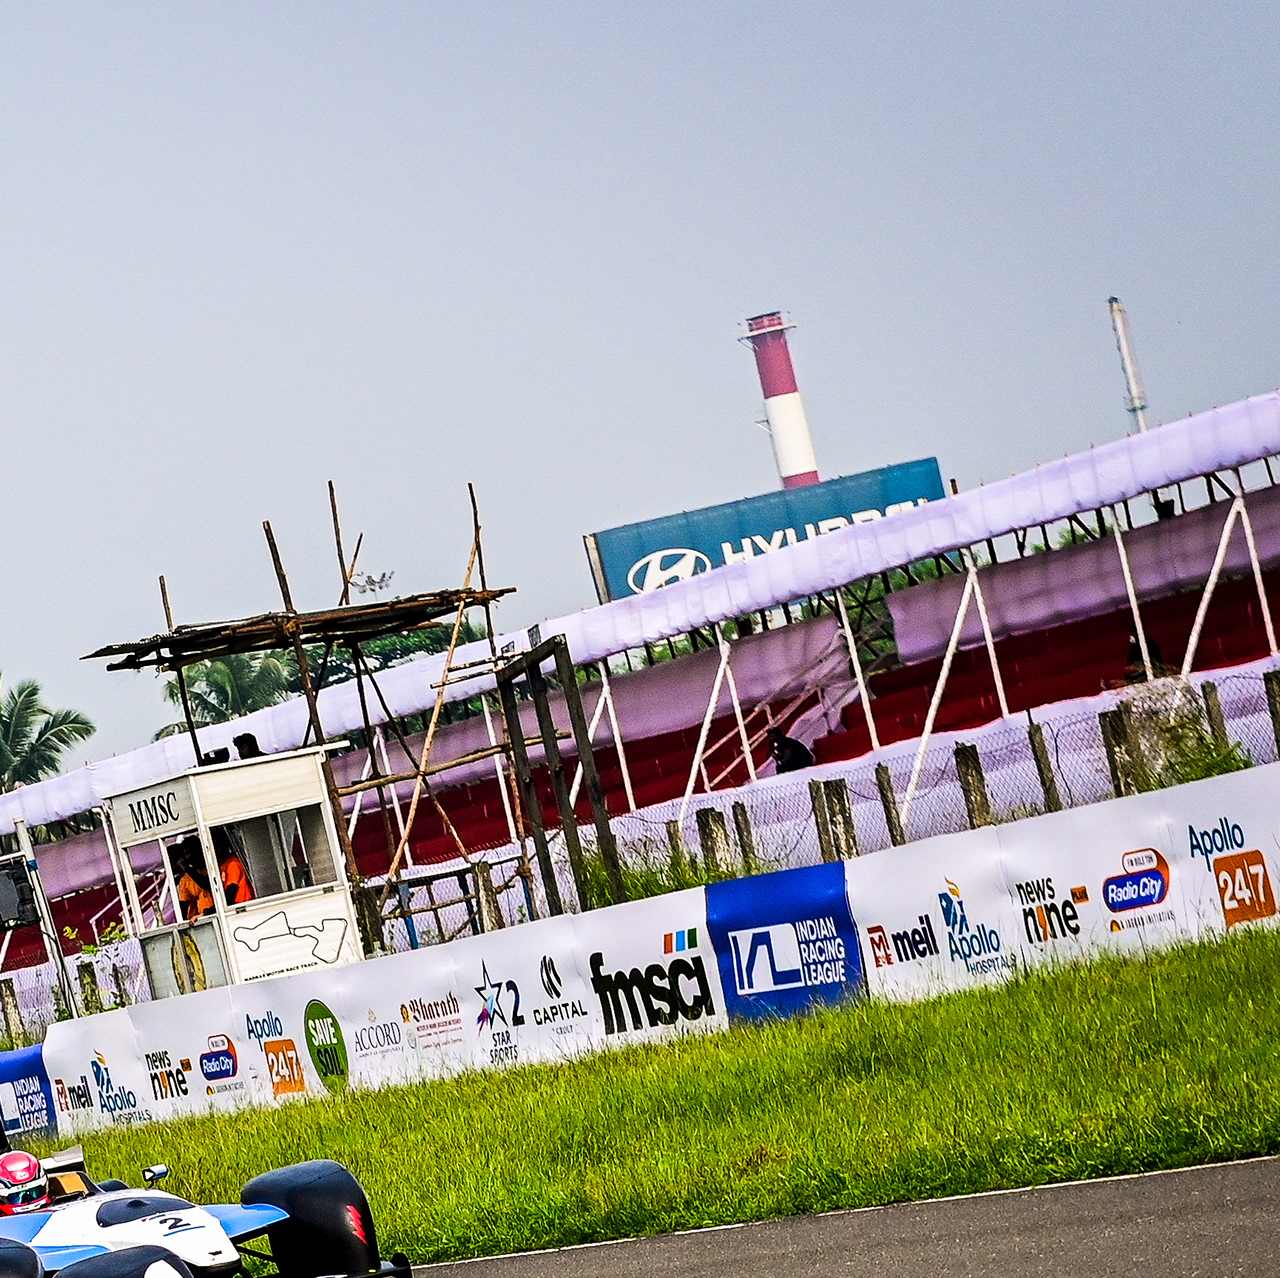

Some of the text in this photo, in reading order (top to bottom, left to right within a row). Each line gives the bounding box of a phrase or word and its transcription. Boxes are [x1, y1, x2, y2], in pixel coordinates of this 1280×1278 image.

[128, 791, 180, 833] MMSC
[1188, 816, 1245, 872] Apollo
[1016, 877, 1055, 905] news
[1108, 876, 1162, 904] Radio City
[795, 916, 837, 942] INDIAN
[1022, 899, 1080, 944] nine
[799, 937, 845, 964] RACING
[891, 914, 939, 962] meil
[948, 923, 1000, 973] Apollo
[803, 960, 846, 987] LEAGUE
[969, 953, 1017, 976] HOSPITALS
[409, 991, 460, 1023] Bharath
[506, 980, 525, 1027] 2
[589, 952, 715, 1035] fmsci
[533, 999, 588, 1026] CAPITAL
[246, 1010, 283, 1052] Apollo
[308, 1017, 338, 1047] SAVE
[354, 1022, 401, 1052] ACCORD
[492, 1030, 512, 1047] STAR
[145, 1050, 171, 1071] news
[202, 1058, 221, 1076] Radio
[220, 1055, 234, 1076] City
[317, 1047, 345, 1077] SOIL
[489, 1045, 519, 1063] SPORTS
[13, 1075, 40, 1096] INDIAN
[68, 1075, 94, 1109] meil
[150, 1068, 189, 1101] nine
[18, 1092, 47, 1114] RACING
[98, 1086, 137, 1121] Apollo
[22, 1111, 49, 1131] LEAGUE
[159, 1217, 191, 1230] 2
